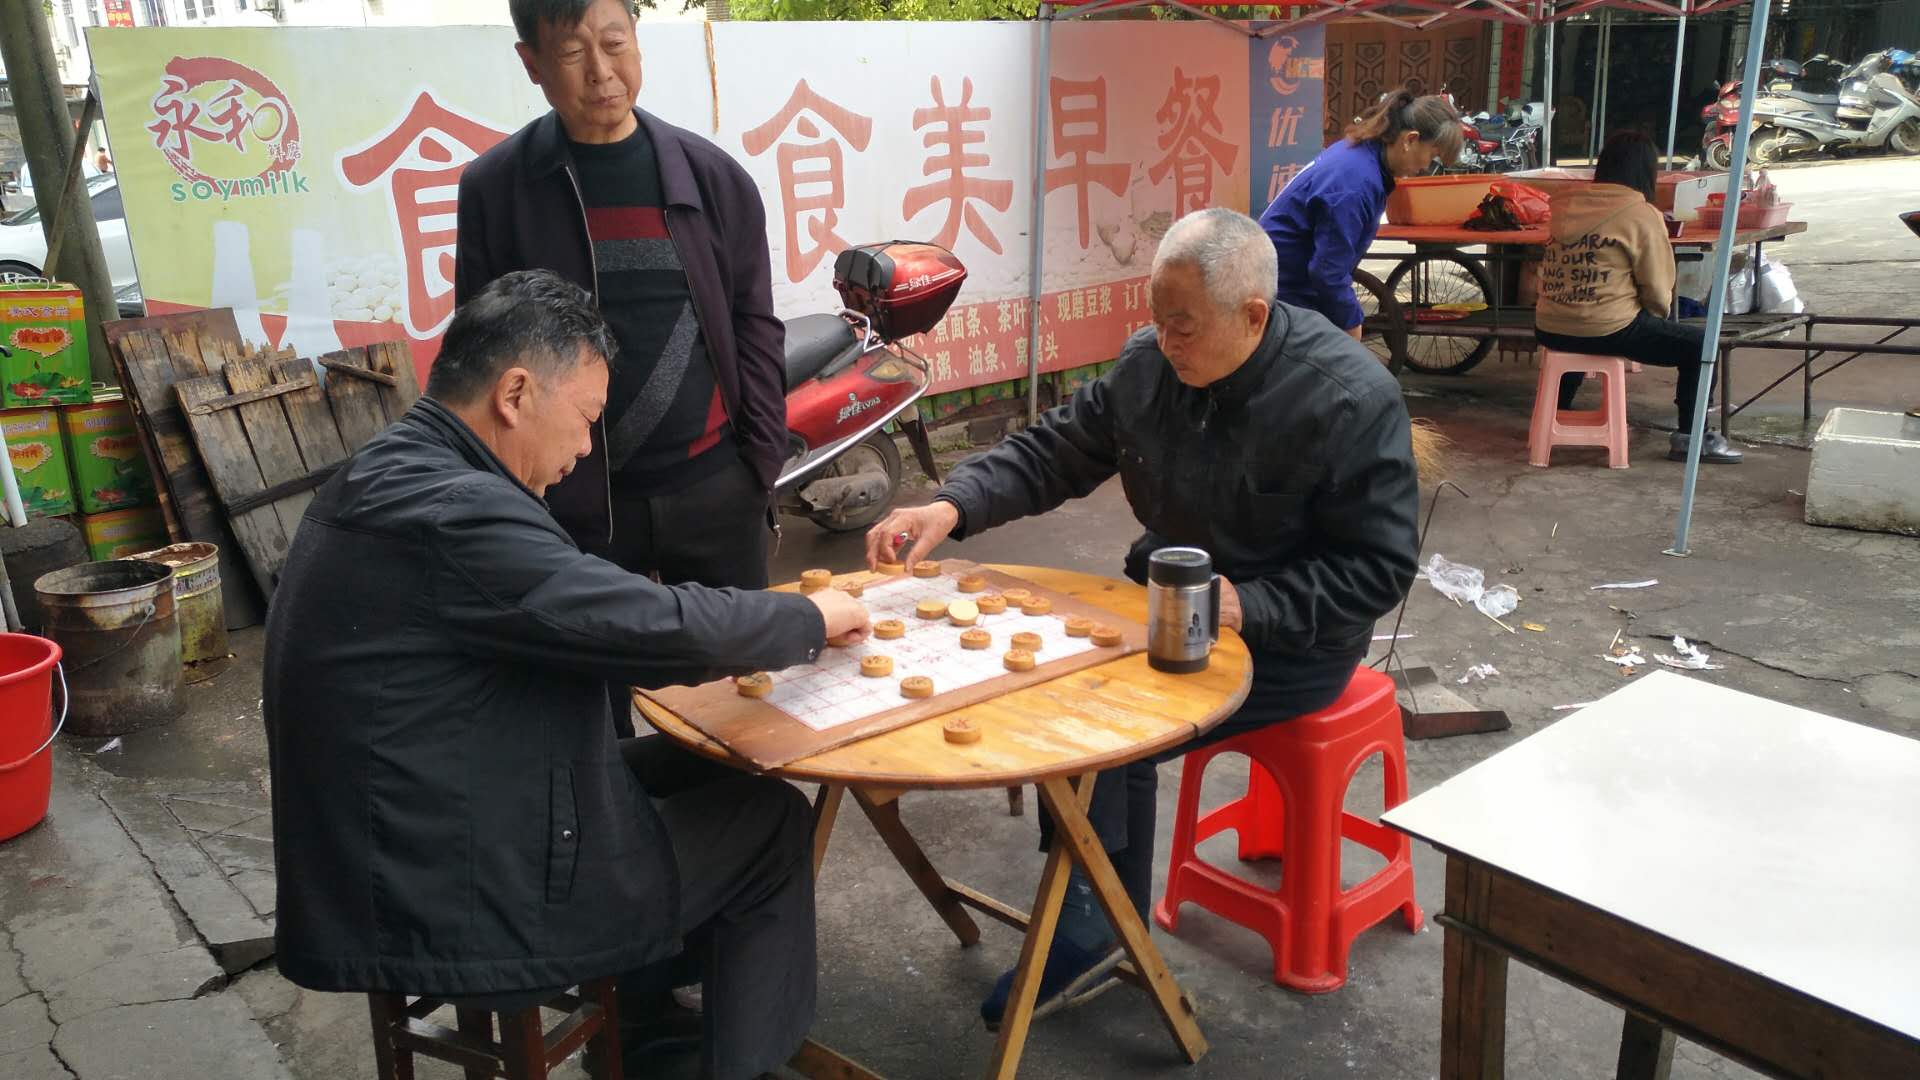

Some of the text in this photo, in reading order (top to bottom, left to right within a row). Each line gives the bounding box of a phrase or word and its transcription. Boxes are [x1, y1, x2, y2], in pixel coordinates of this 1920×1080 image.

[147, 83, 283, 160] 永和
[171, 171, 310, 201] soymilk
[1571, 269, 1611, 284] SHIT
